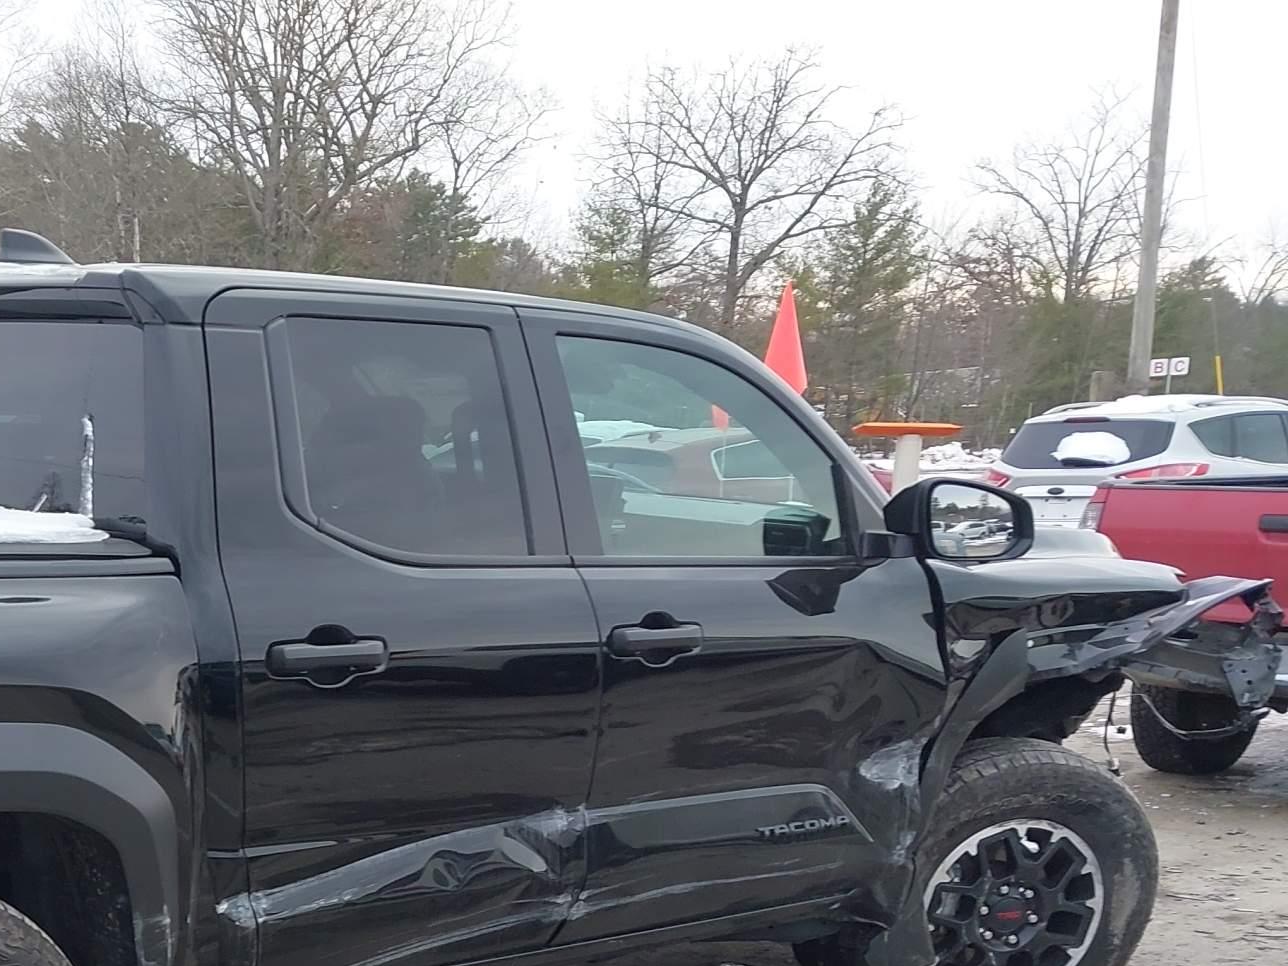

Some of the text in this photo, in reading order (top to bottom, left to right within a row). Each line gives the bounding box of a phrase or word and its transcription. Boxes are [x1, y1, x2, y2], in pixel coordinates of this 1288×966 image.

[1154, 361, 1164, 374] B
[1174, 360, 1185, 373] C
[755, 814, 851, 837] TACOMA
